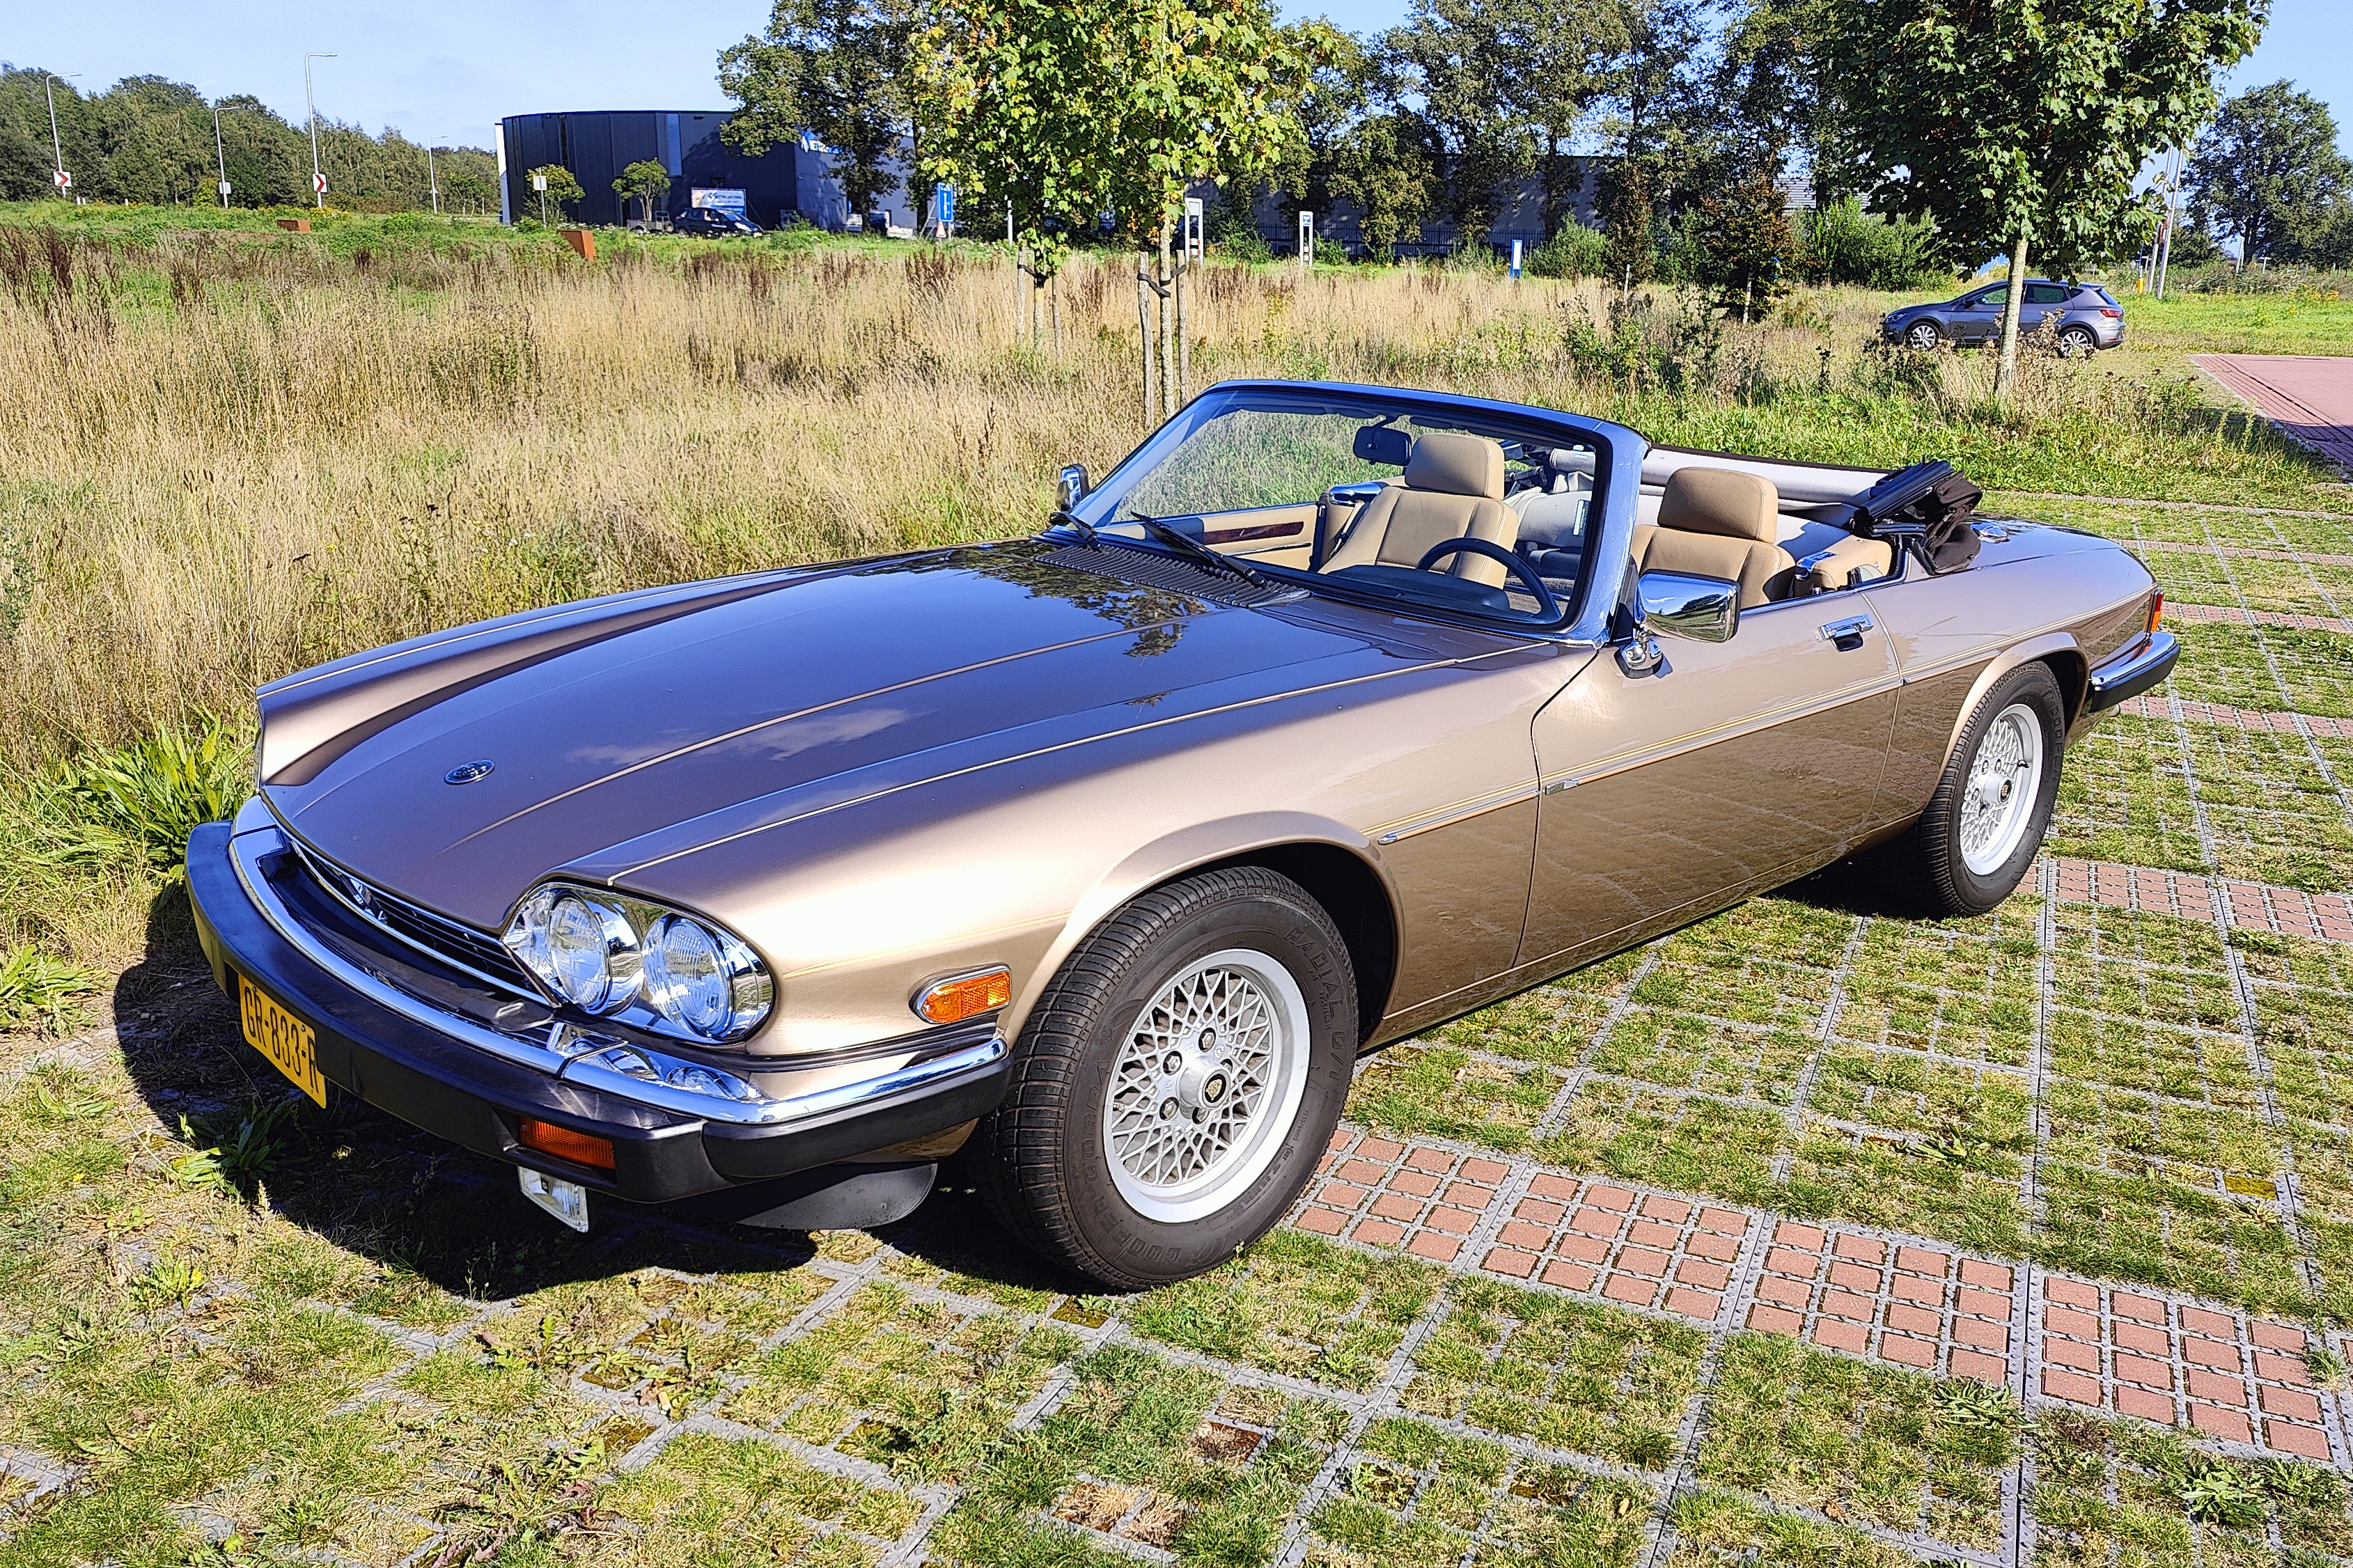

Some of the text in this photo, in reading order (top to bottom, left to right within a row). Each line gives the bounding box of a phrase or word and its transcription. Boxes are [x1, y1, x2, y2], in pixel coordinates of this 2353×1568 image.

[2050, 705, 2063, 783] COOPER
[1283, 926, 1343, 1019] RADIAL
[245, 986, 320, 1094] GR-833-R
[1082, 1060, 1181, 1263] COOPER COBRA
